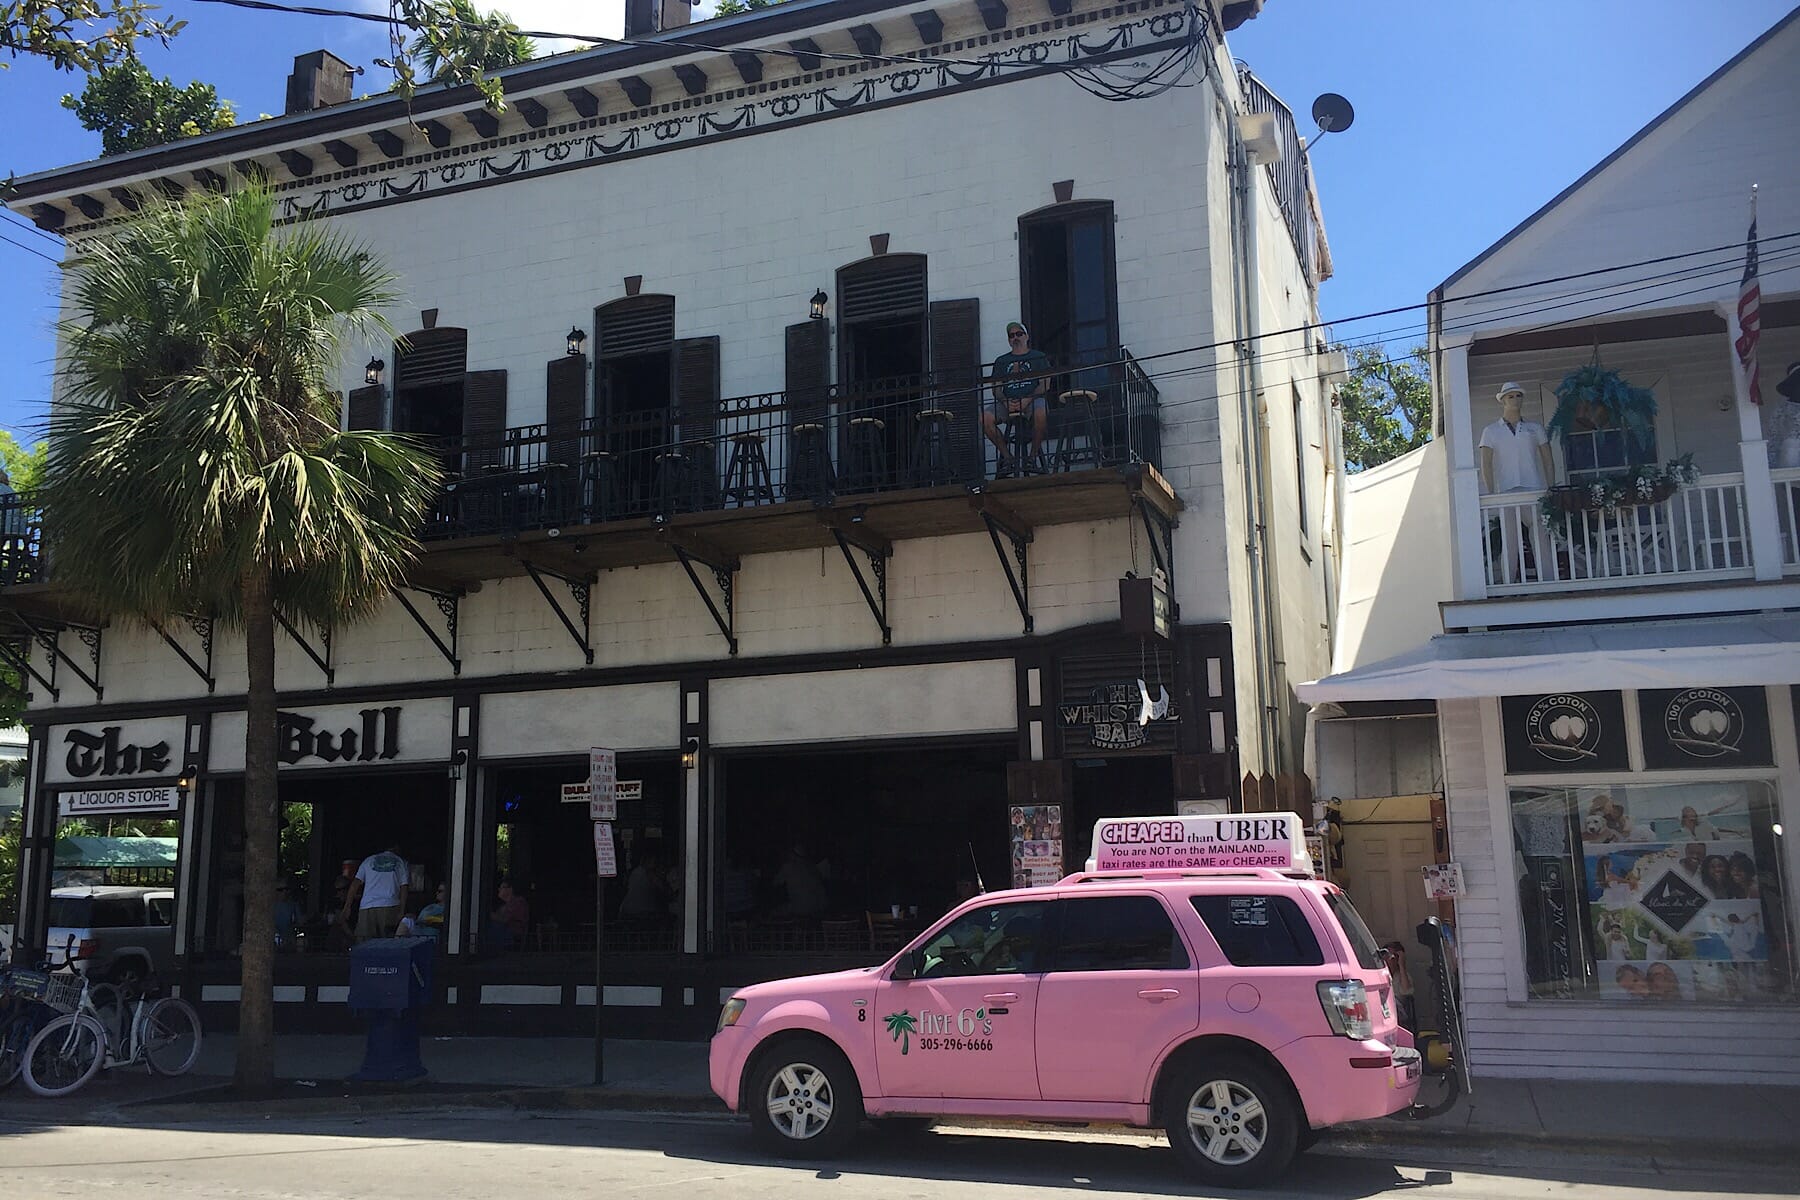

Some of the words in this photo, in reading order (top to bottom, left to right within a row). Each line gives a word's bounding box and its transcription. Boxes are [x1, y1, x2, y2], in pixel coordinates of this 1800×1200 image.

[1092, 684, 1141, 703] THE
[1060, 703, 1180, 724] WHISTE
[1529, 711, 1541, 727] 100
[1548, 696, 1588, 712] COTON
[1668, 704, 1680, 721] 100
[1688, 690, 1729, 706] COTON
[277, 706, 402, 764] Bull
[1094, 722, 1144, 742] BAR
[64, 726, 172, 778] The
[79, 790, 125, 806] LIQUOR
[127, 788, 170, 804] STORE
[1101, 821, 1184, 844] CHEAPER
[1187, 832, 1214, 844] than
[1216, 819, 1289, 842] UBER
[1111, 847, 1130, 857] You
[1150, 846, 1172, 856] NOT
[1189, 846, 1205, 855] the
[1102, 860, 1120, 869] taxi
[1122, 860, 1146, 868] rates
[1167, 858, 1183, 867] the
[1186, 857, 1216, 867] SAME
[1232, 856, 1286, 866] CHEAPER
[857, 1008, 866, 1022] 8
[919, 1009, 952, 1036] FIVE
[920, 1038, 993, 1051] 305-296-6666
